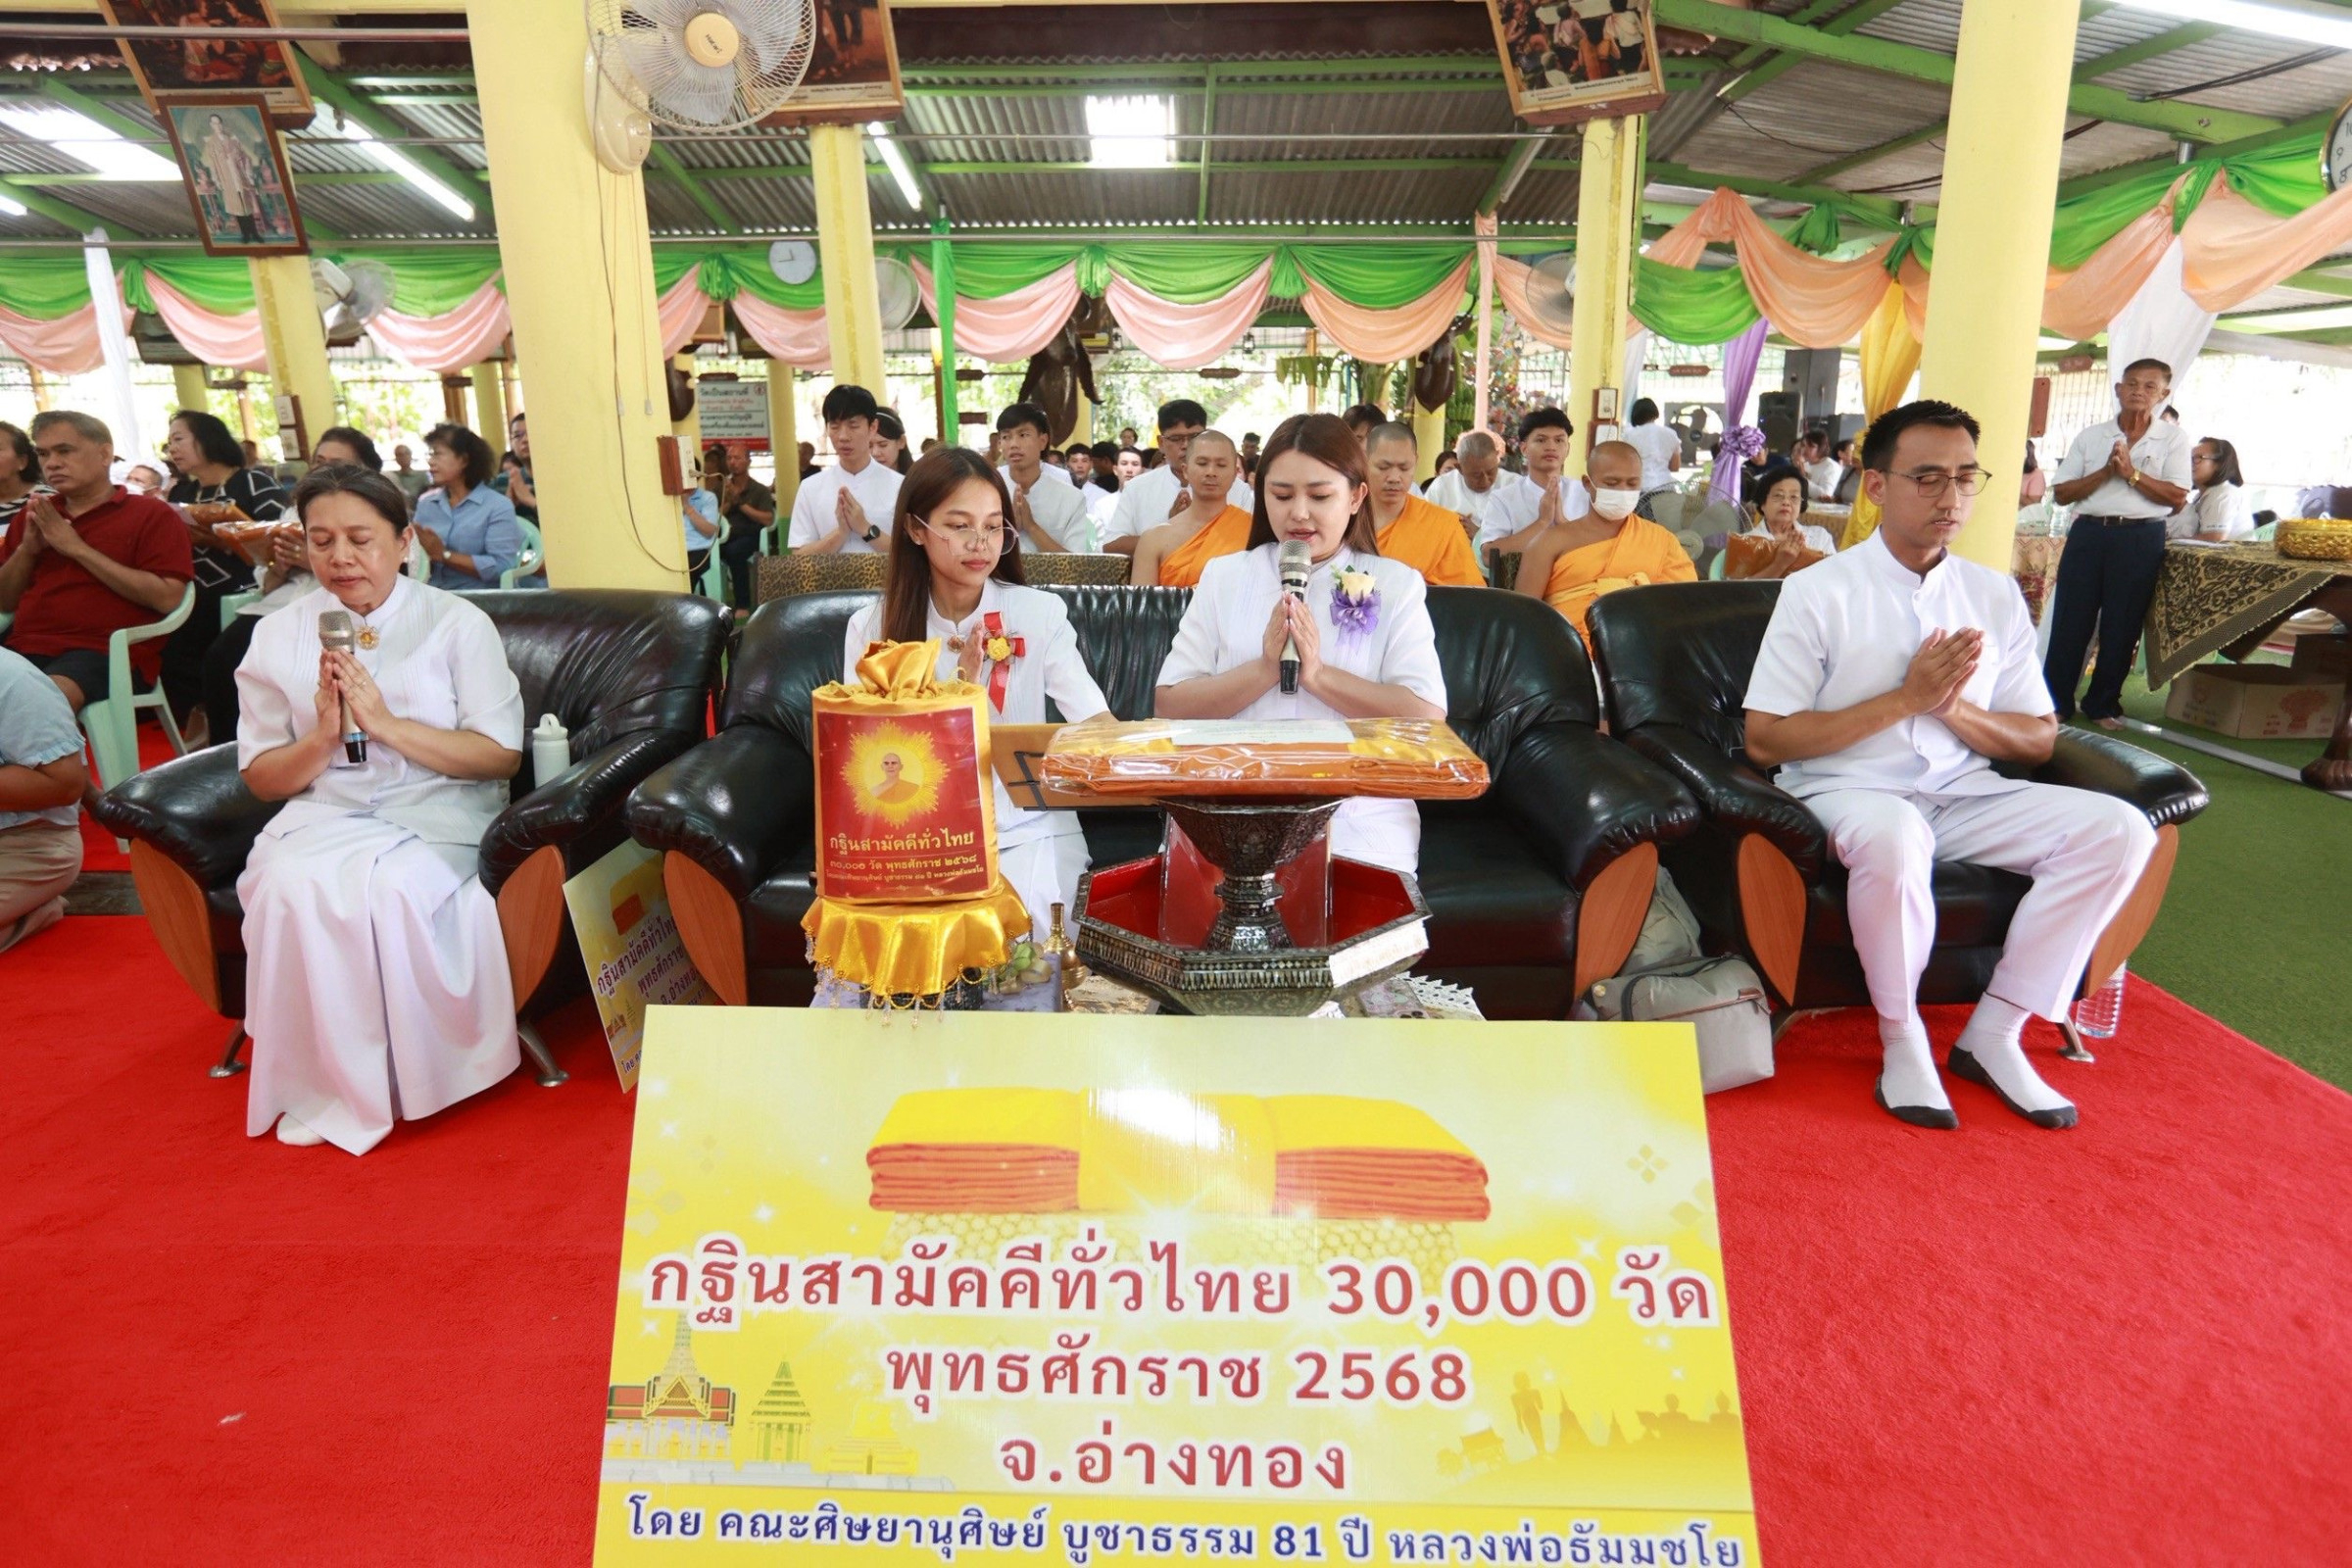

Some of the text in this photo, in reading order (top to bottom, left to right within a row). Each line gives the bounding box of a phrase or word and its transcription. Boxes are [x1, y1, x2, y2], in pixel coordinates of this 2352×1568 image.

[829, 827, 974, 856] กฐินสามัคคีทั่วไทย
[597, 914, 678, 997] กฐินสามัคคีทั่วไท
[652, 1229, 1710, 1327] กฐินสามัคคีทั่วไทย 30,000 วัด
[887, 1333, 1467, 1412] พุทธศักราช 2568
[1002, 1420, 1346, 1489] จ.อ่างทอง
[629, 1494, 1740, 1568] โดย คณะศิษยานุศิษย์ บูชาธรรม 81 ปี หลวงพ่อธัมมชโย
